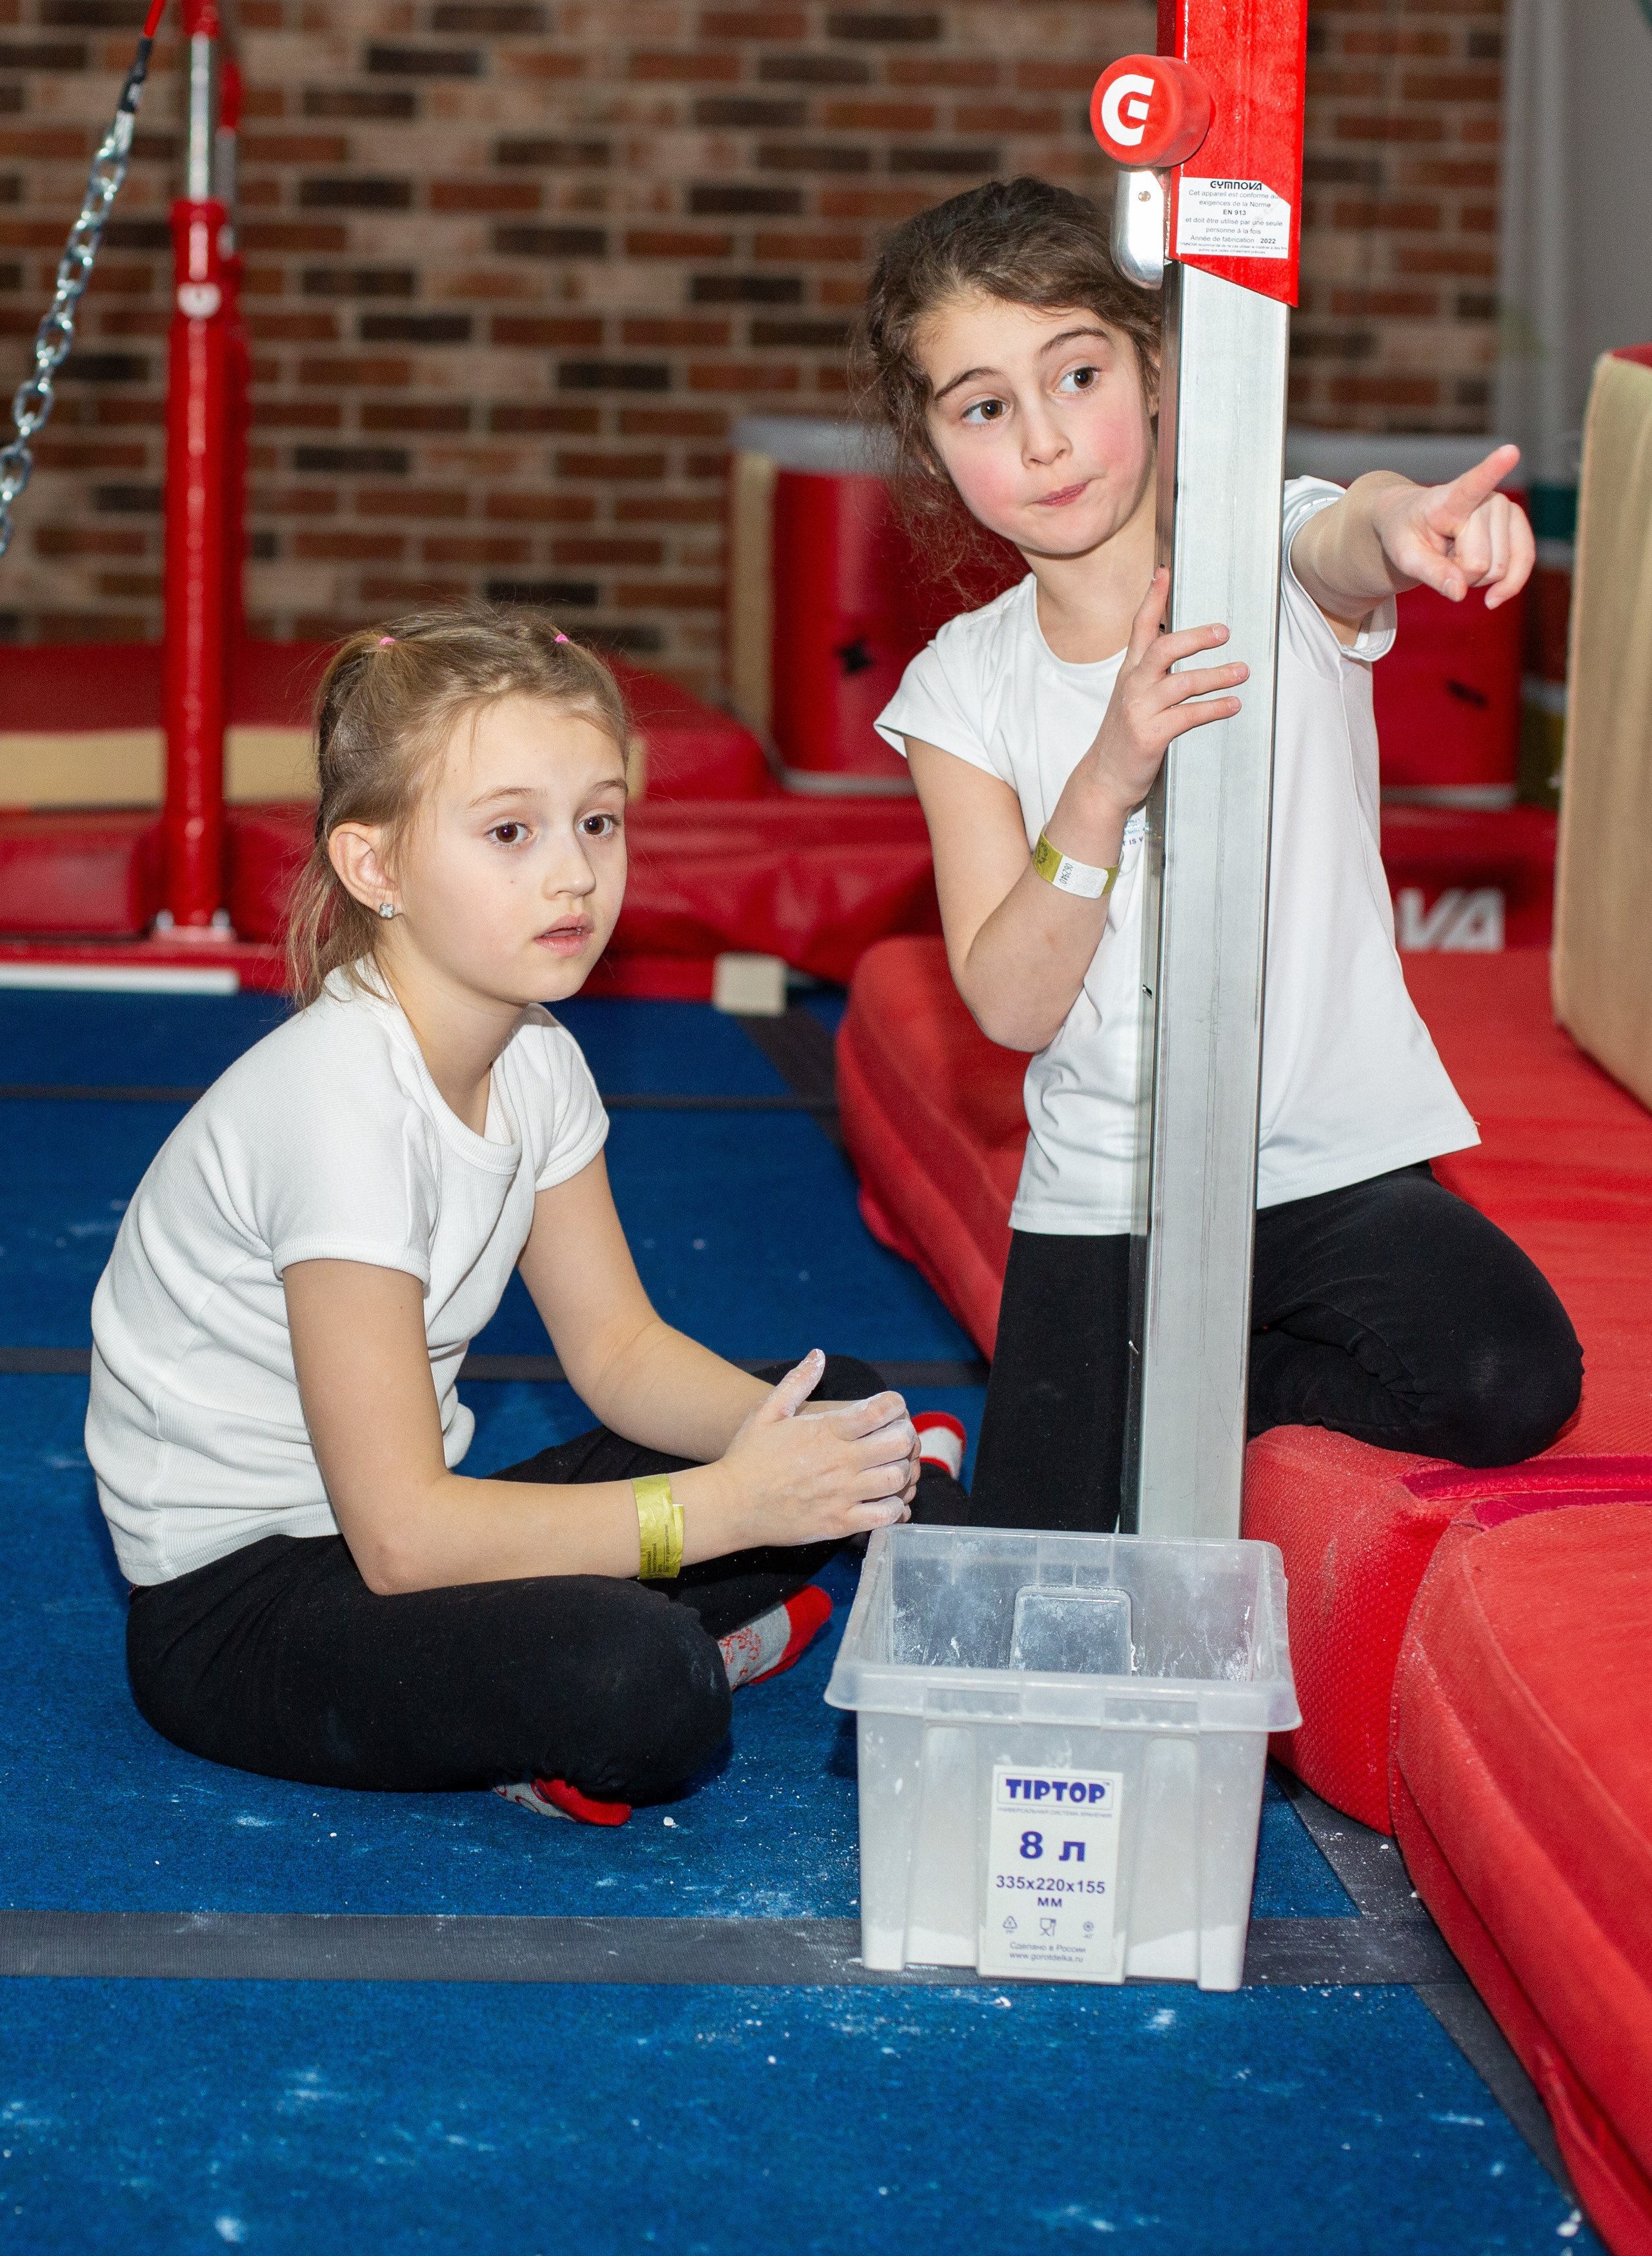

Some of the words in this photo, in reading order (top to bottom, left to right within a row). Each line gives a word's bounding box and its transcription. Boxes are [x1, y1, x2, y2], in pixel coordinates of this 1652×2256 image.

[1210, 181, 1262, 190] GYMNOVA
[1393, 887, 1506, 954] VA
[1005, 1778, 1105, 1804] TIPTOP
[1020, 1831, 1043, 1859] 8
[1058, 1840, 1085, 1862] л
[1010, 1941, 1047, 1951] Сделано
[1056, 1944, 1086, 1953] России
